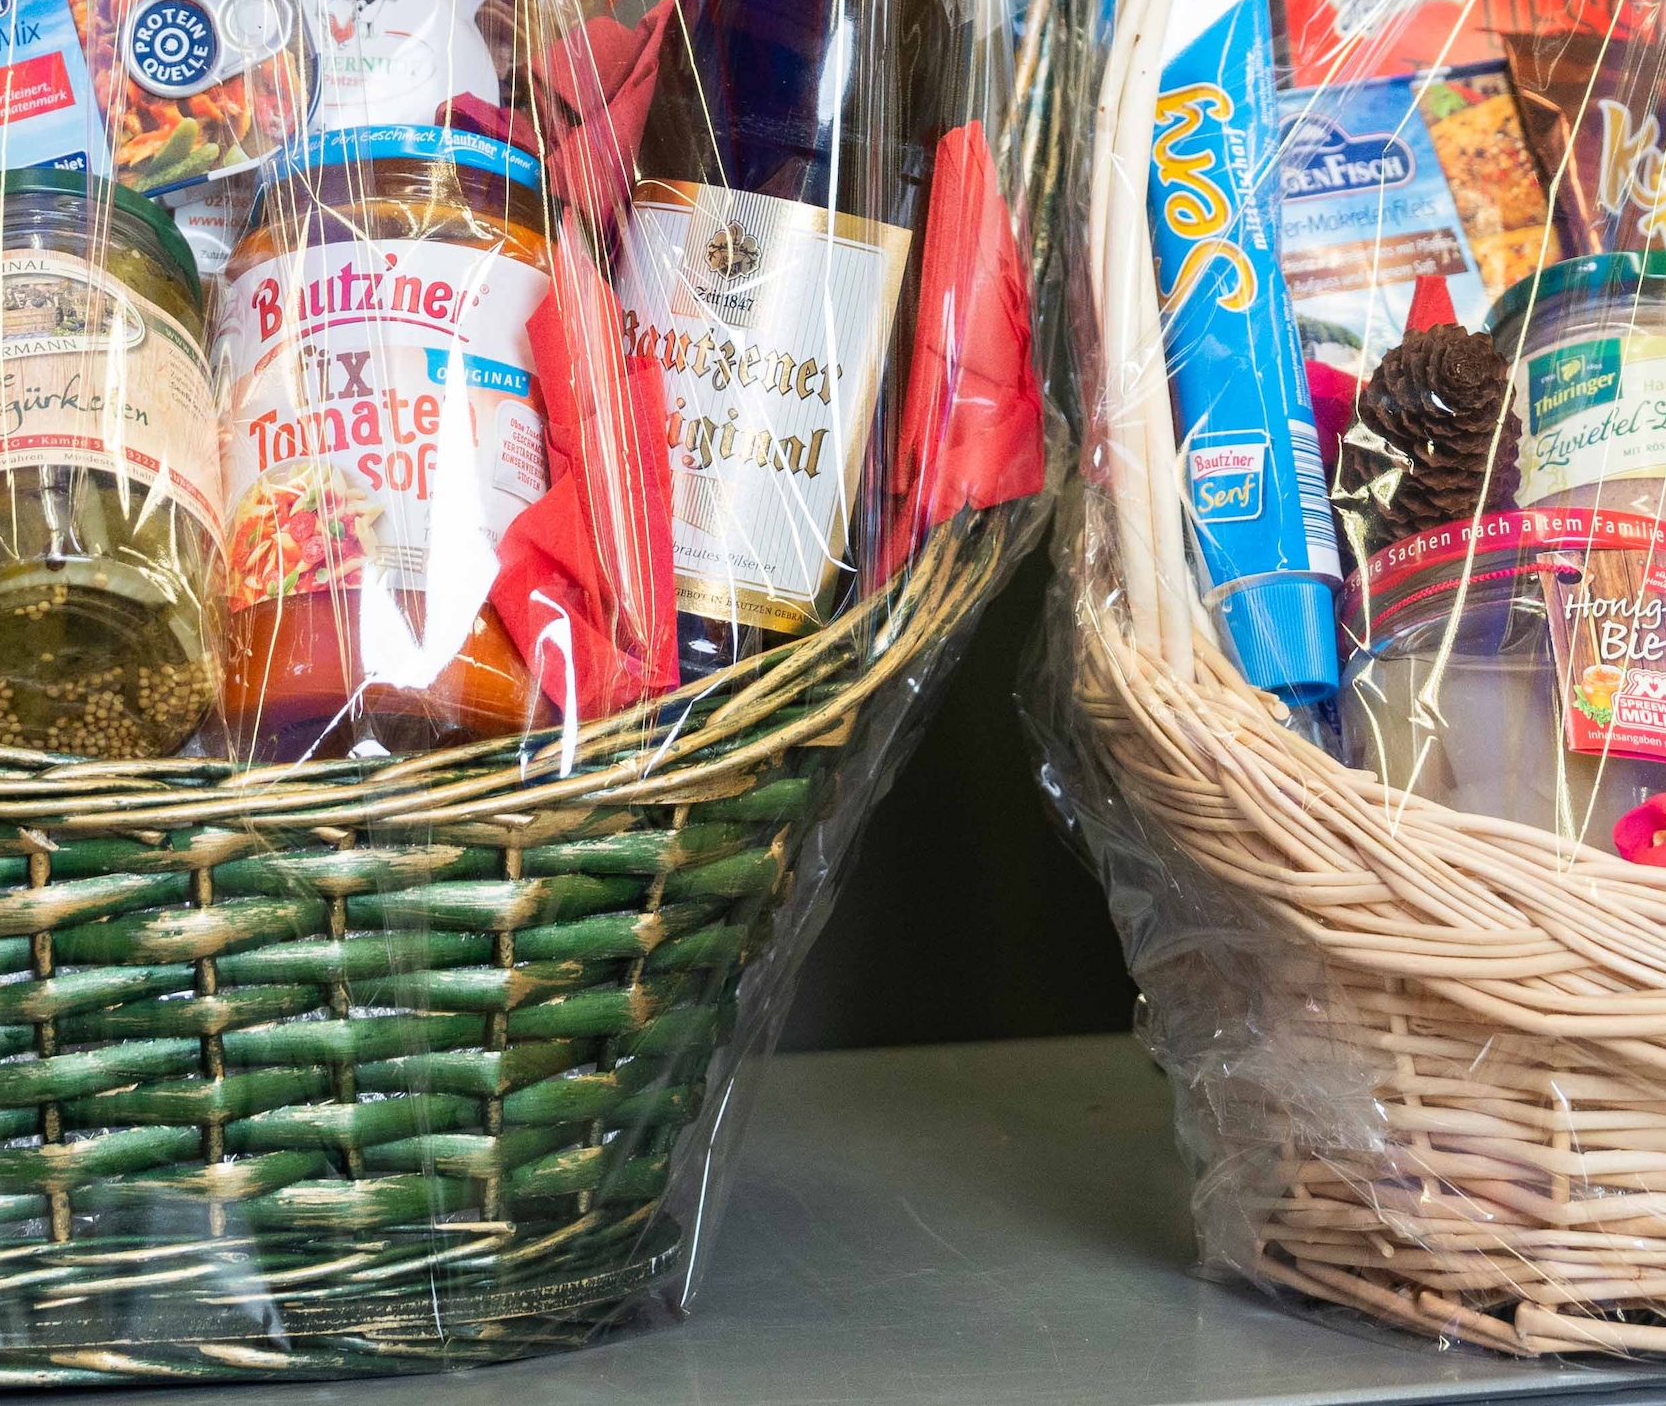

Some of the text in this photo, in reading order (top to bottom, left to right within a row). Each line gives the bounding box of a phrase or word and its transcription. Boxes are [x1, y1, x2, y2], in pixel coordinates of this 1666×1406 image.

[135, 8, 207, 54] PROTEIN
[142, 44, 209, 82] QUELLE
[360, 128, 437, 145] Geschmack
[723, 293, 755, 312] 1847
[436, 366, 527, 390] OGINAL
[1533, 371, 1616, 417] Thüringer
[250, 389, 479, 473] Tomate
[665, 396, 830, 479] iginal
[126, 448, 157, 468] 3222
[1193, 447, 1255, 470] Bautz'ner
[1198, 470, 1257, 513] Senf
[1388, 530, 1452, 564] Sachen
[1460, 515, 1511, 543] nach
[1521, 515, 1583, 534] altem
[1587, 730, 1662, 748] Inhaltsangaben
